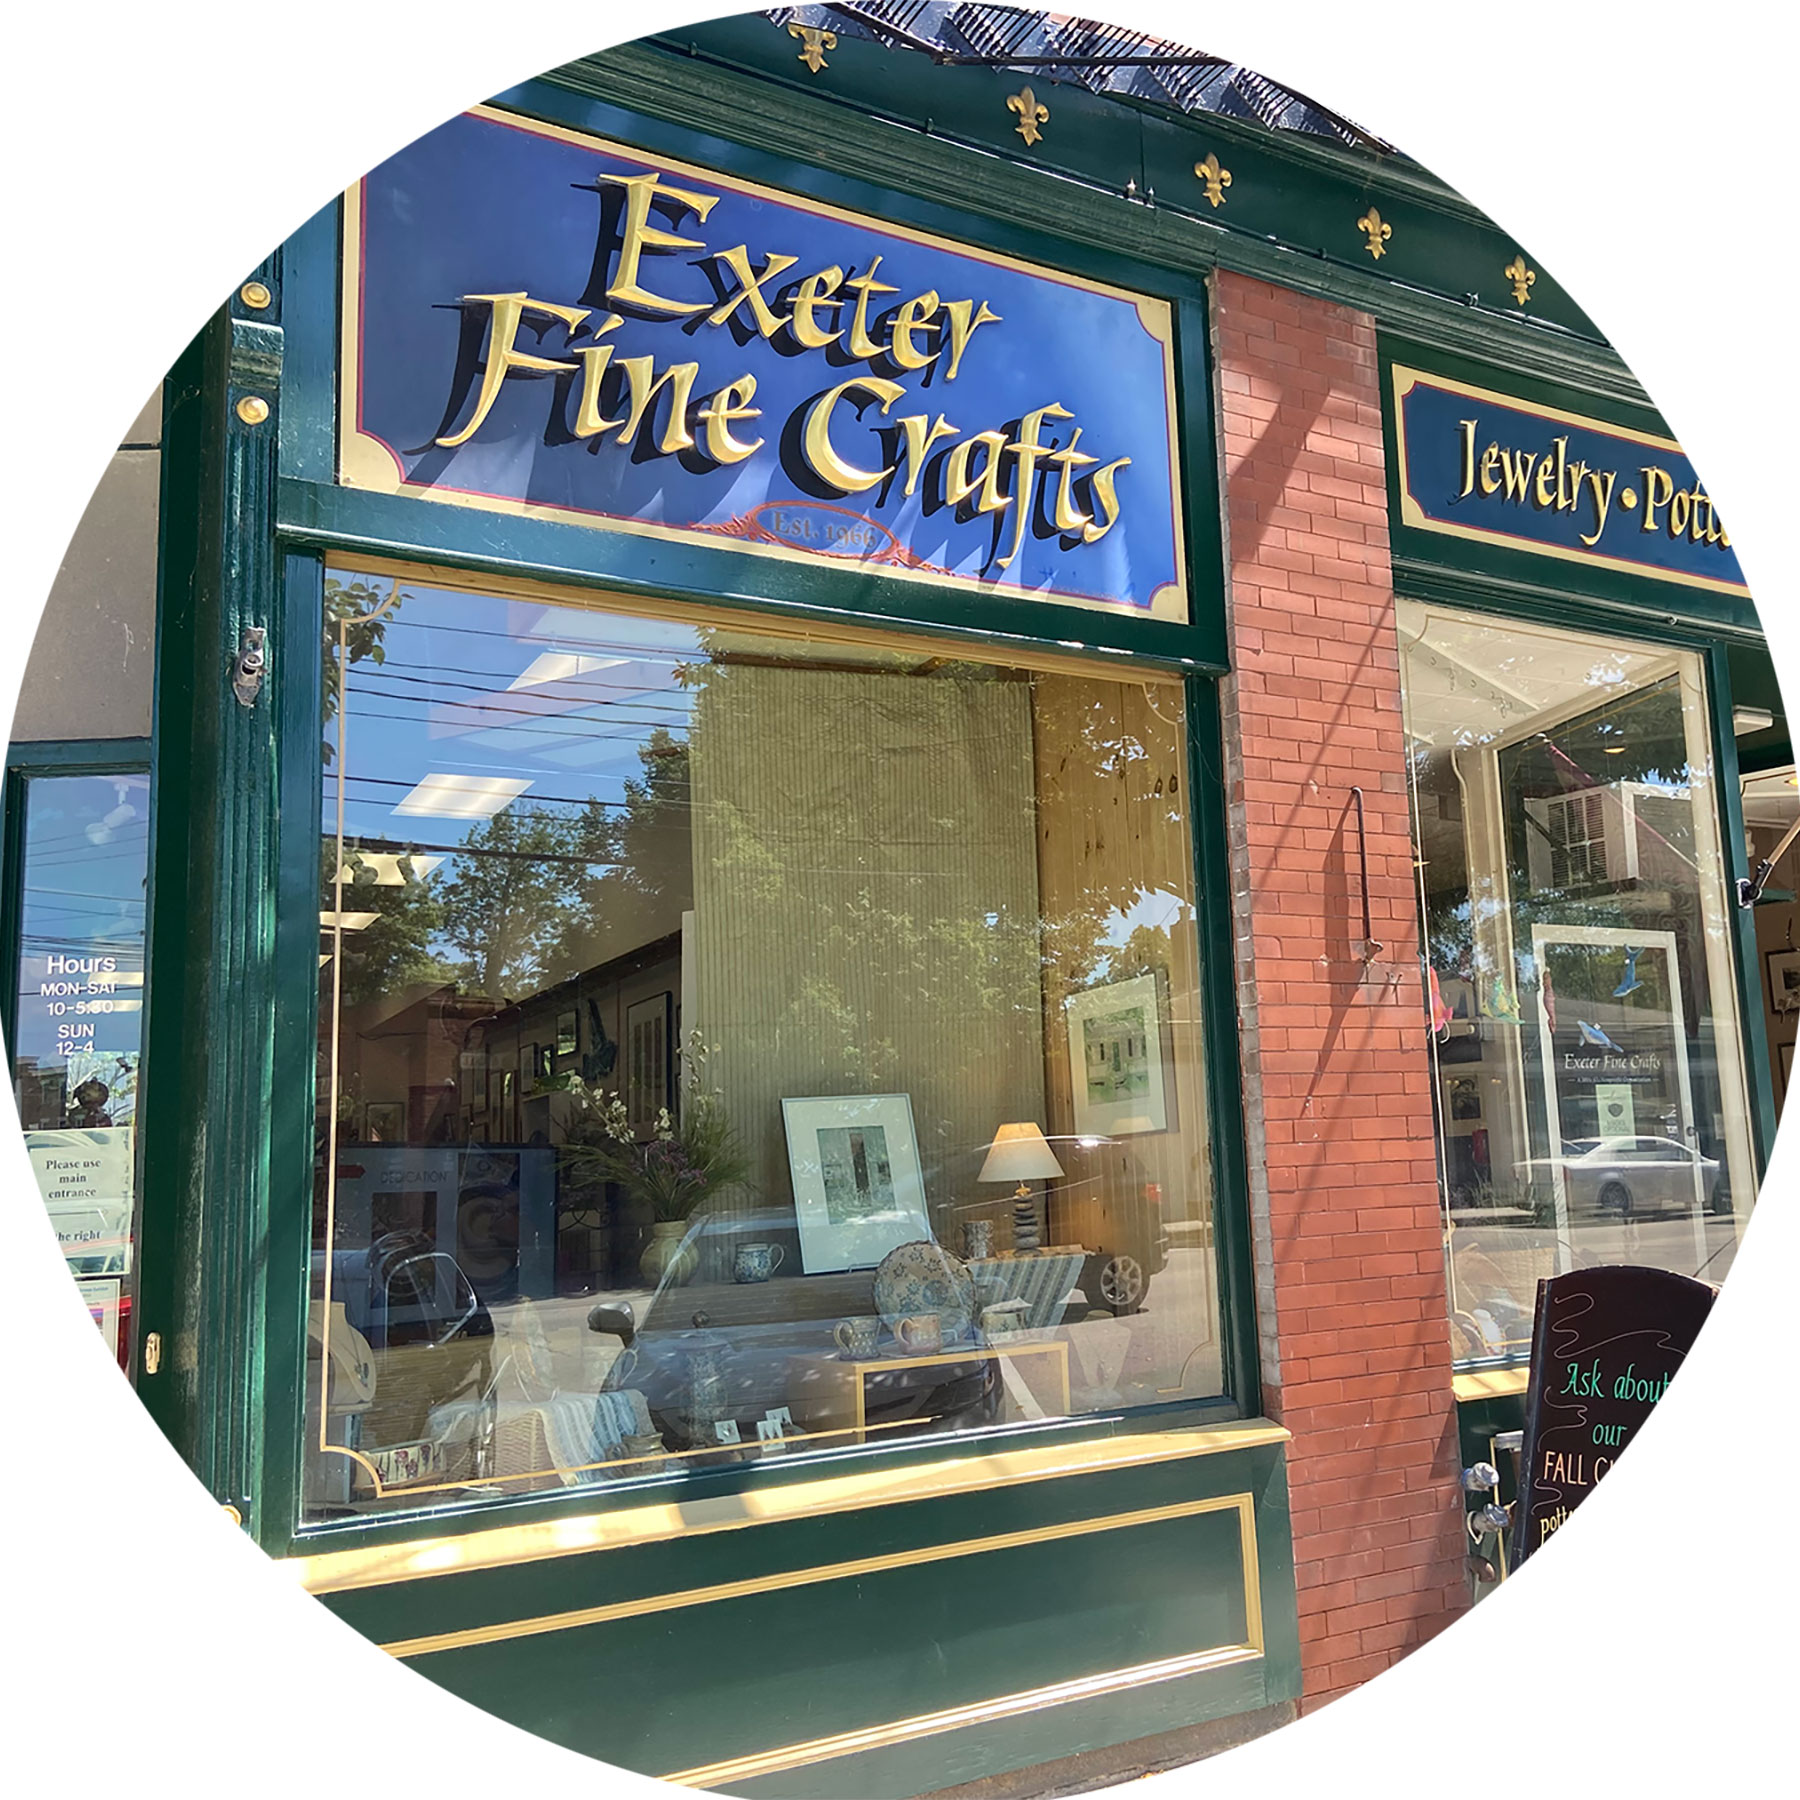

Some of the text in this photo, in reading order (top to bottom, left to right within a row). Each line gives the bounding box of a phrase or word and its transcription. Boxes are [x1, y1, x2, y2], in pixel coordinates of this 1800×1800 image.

[599, 172, 1003, 381] Exeter
[435, 291, 1132, 569] Fine Crafts
[1459, 419, 1617, 546] Jewelry
[773, 511, 877, 549] Est. 1966
[47, 954, 117, 975] Hours
[40, 981, 117, 997] MON-SAT
[46, 1000, 114, 1016] 10-5:30
[57, 1023, 95, 1039] SUN
[55, 1040, 95, 1056] 12-4
[1564, 1052, 1661, 1072] Exeter Fine Crafts
[46, 1159, 102, 1170] Please use
[59, 1173, 87, 1184] main
[48, 1188, 97, 1199] entrance
[55, 1230, 101, 1242] he right
[1560, 1358, 1605, 1398] Ask
[1592, 1423, 1628, 1447] our
[1543, 1450, 1615, 1486] FALL C
